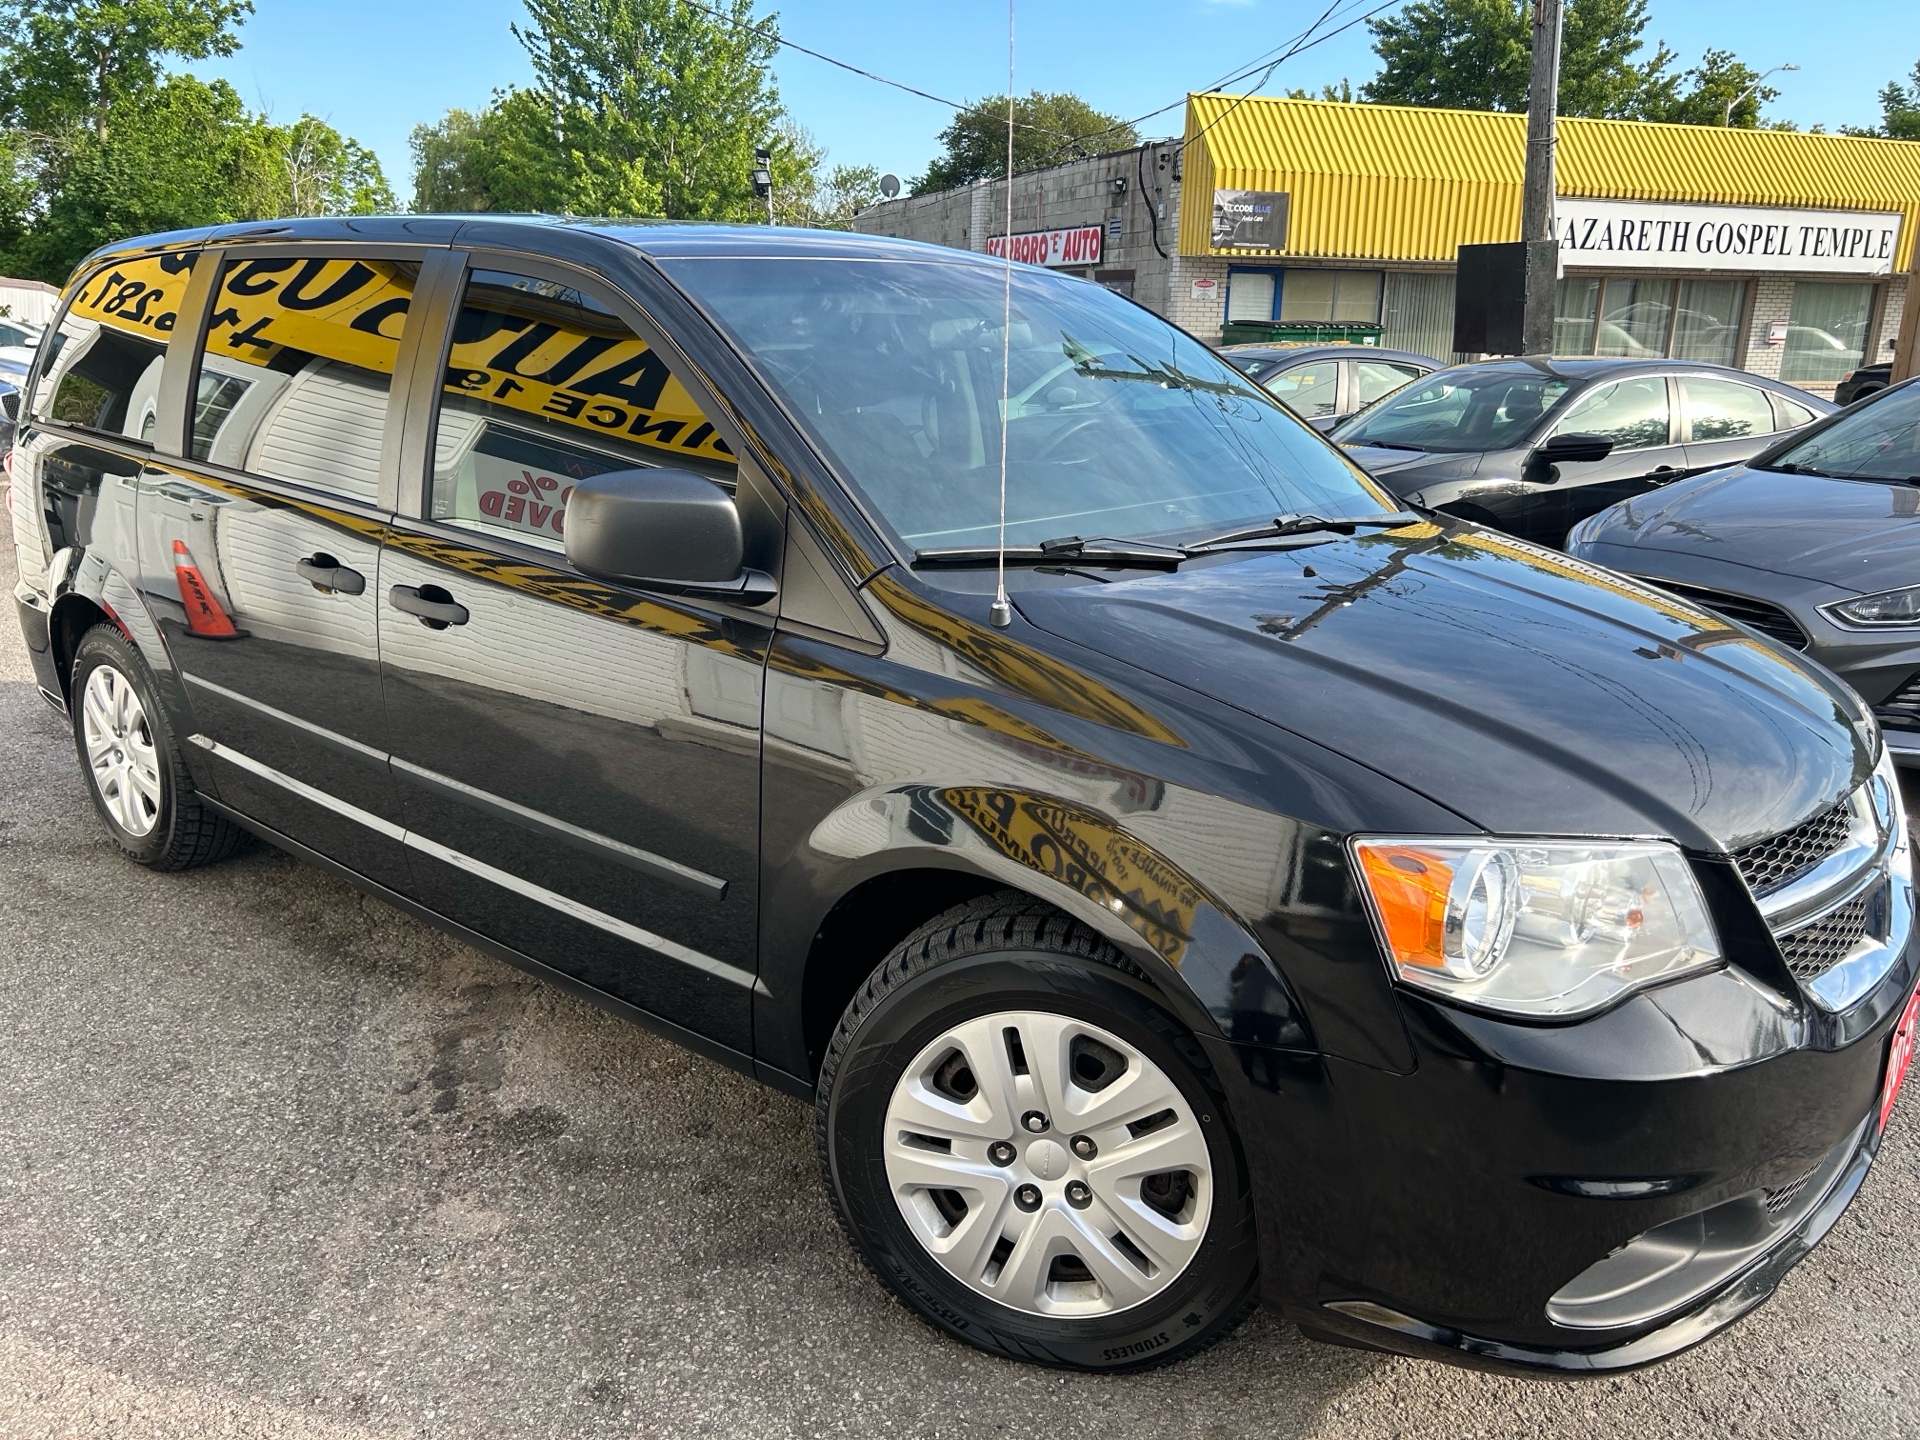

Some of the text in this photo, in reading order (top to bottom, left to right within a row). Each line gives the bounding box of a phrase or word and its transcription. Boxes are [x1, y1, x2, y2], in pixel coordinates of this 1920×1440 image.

[1234, 204, 1271, 213] CODE BLUE
[1062, 228, 1100, 262] AUTO
[1696, 221, 1793, 256] GOSPEL
[1798, 226, 1894, 260] TEMPLE
[1103, 1331, 1170, 1361] STUDLESS
